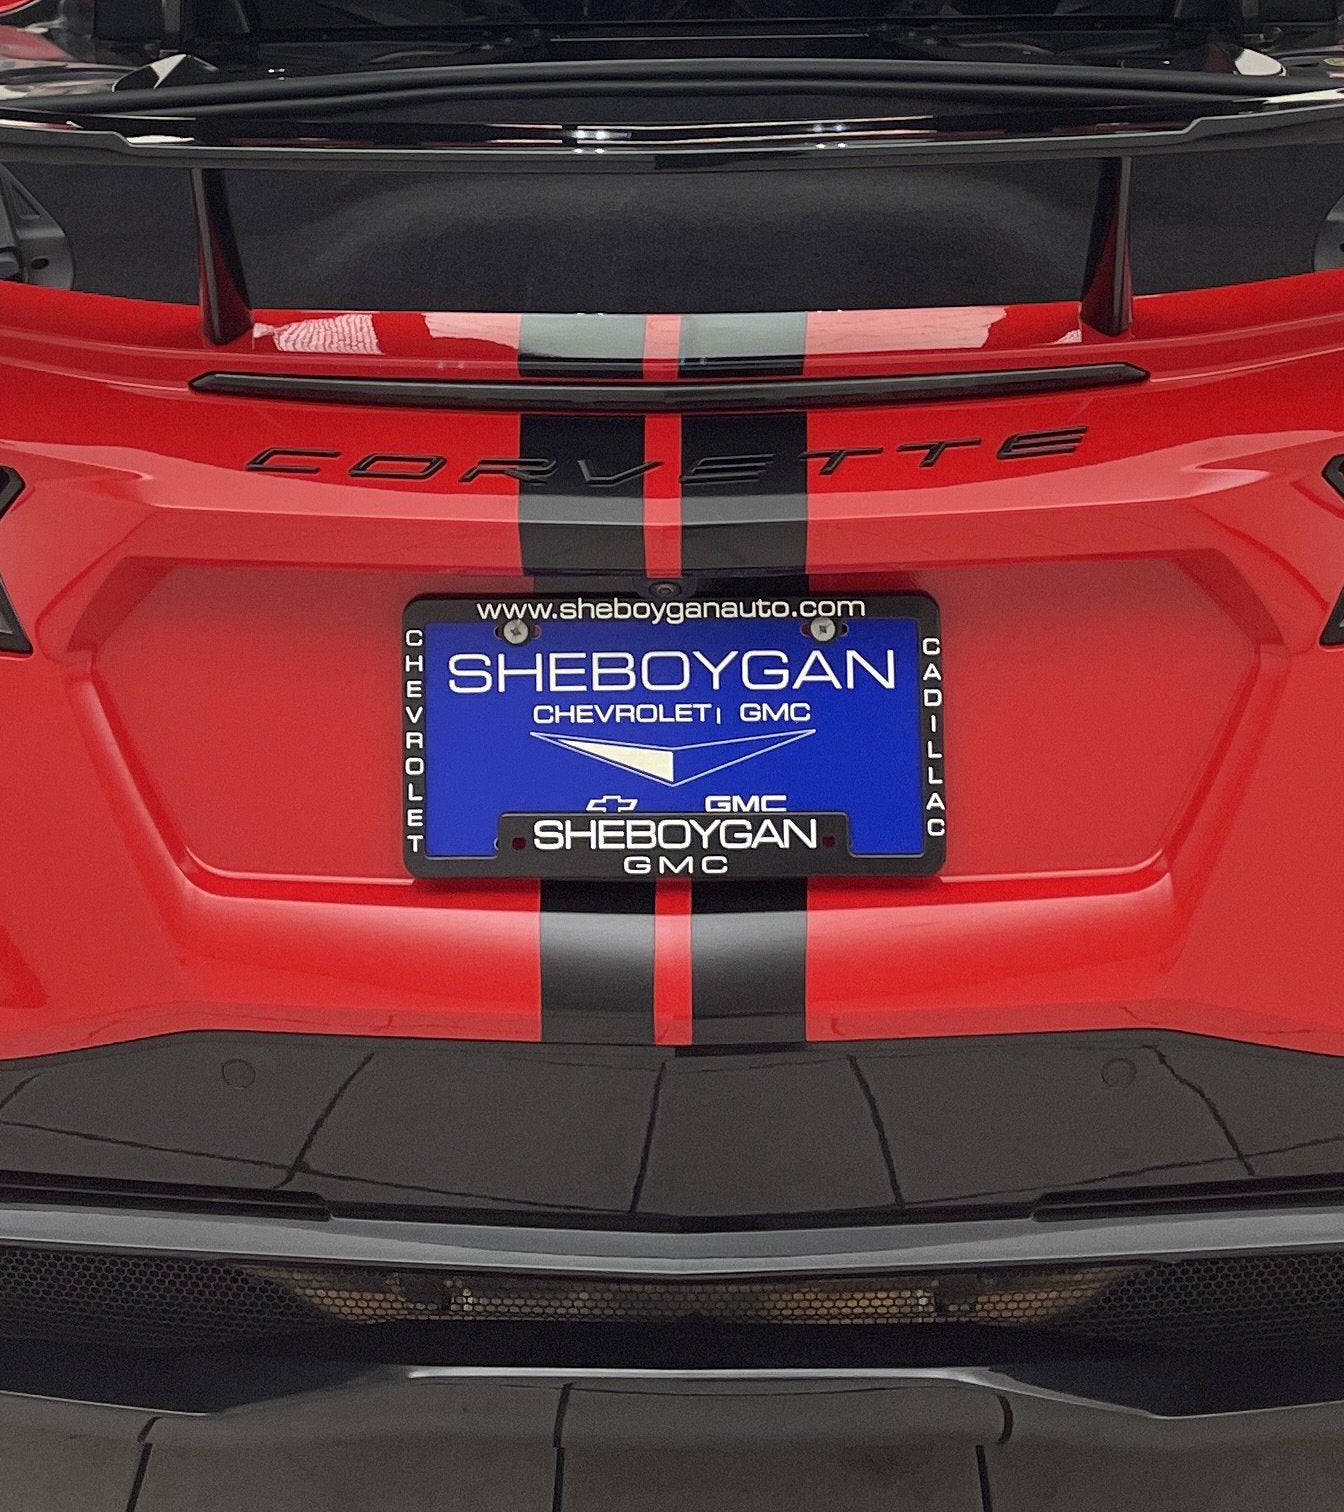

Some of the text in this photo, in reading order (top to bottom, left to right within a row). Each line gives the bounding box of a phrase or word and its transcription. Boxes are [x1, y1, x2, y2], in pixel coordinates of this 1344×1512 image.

[246, 426, 1088, 484] CORVETTE
[477, 598, 865, 624] www.sheboyganauto.com
[448, 650, 896, 693] SHEBOYGAN
[533, 702, 811, 724] CHEVROLET GMC
[404, 629, 425, 852] CHEVROLET
[922, 638, 946, 837] CADILLAC
[704, 795, 787, 812] GMC
[533, 818, 817, 850] SHEBOYGAN
[623, 855, 728, 874] GMC
